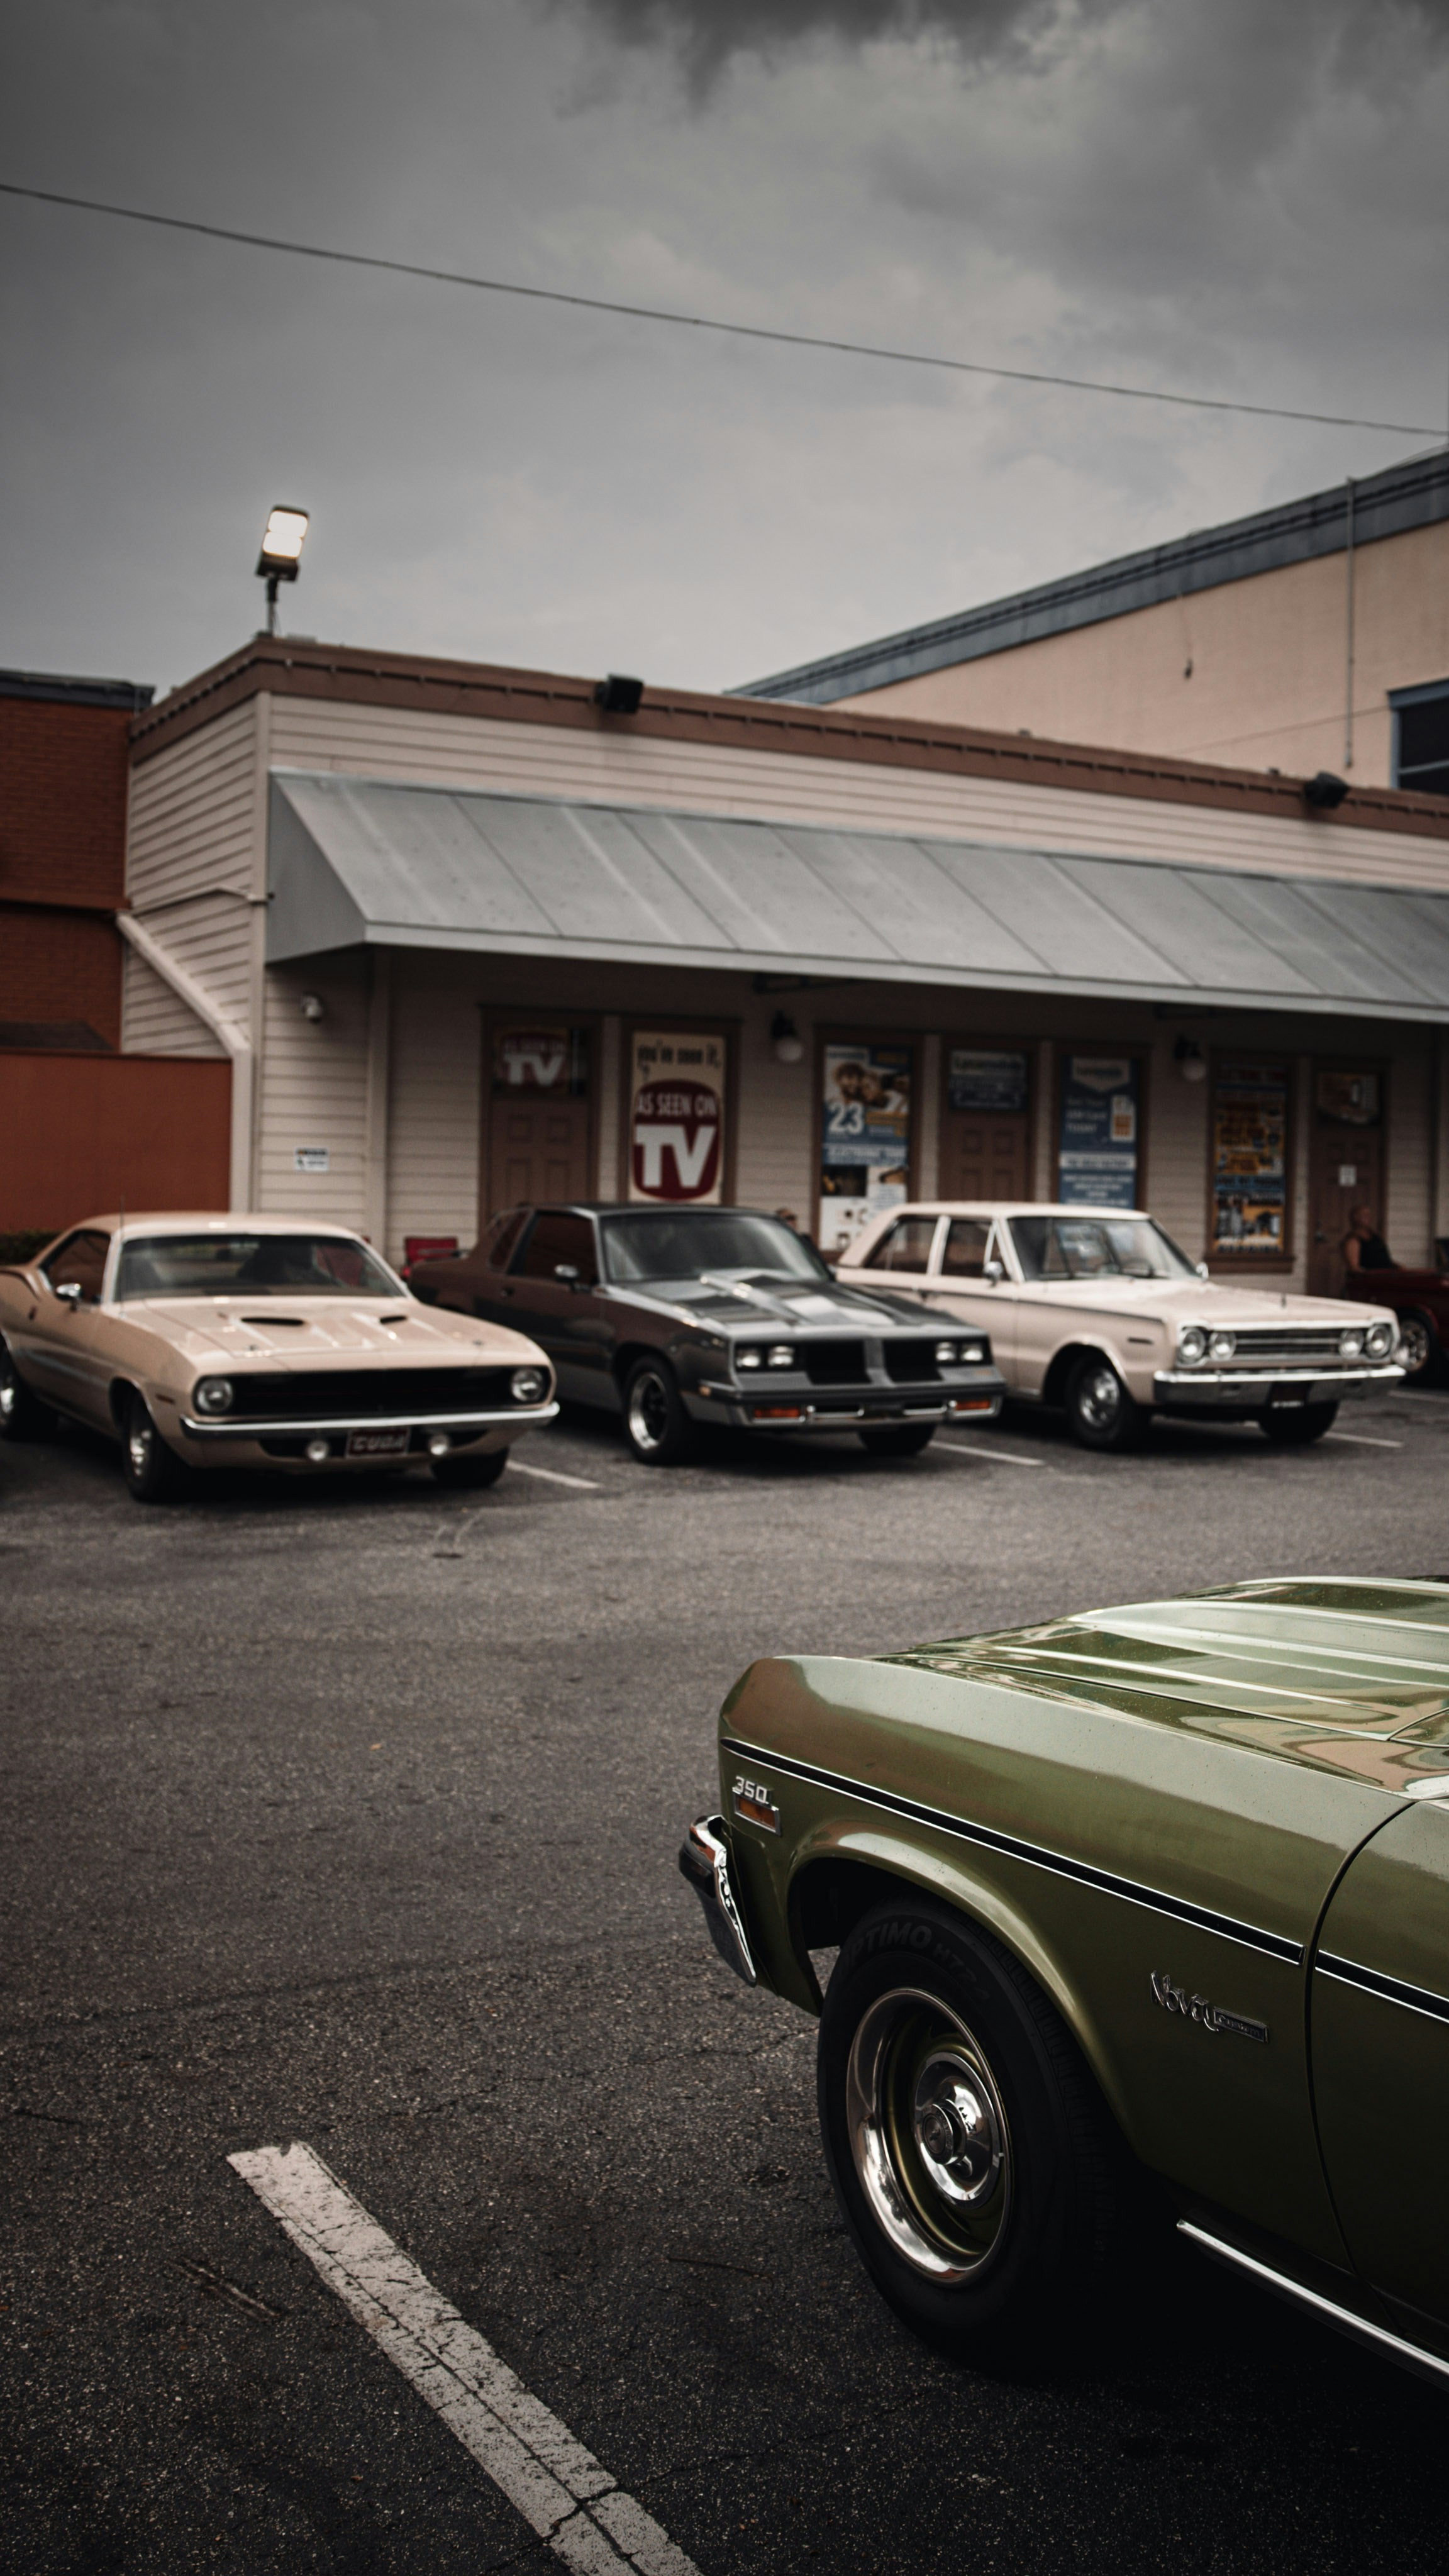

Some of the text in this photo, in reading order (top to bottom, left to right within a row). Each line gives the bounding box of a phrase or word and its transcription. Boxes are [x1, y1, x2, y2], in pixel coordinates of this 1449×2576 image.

[504, 1053, 564, 1087] TV
[637, 1092, 718, 1117] AS SEEN ON
[828, 1101, 863, 1135] 23
[635, 1124, 717, 1189] TV
[731, 1775, 768, 1804] 350
[1150, 1970, 1223, 2032] Nova
